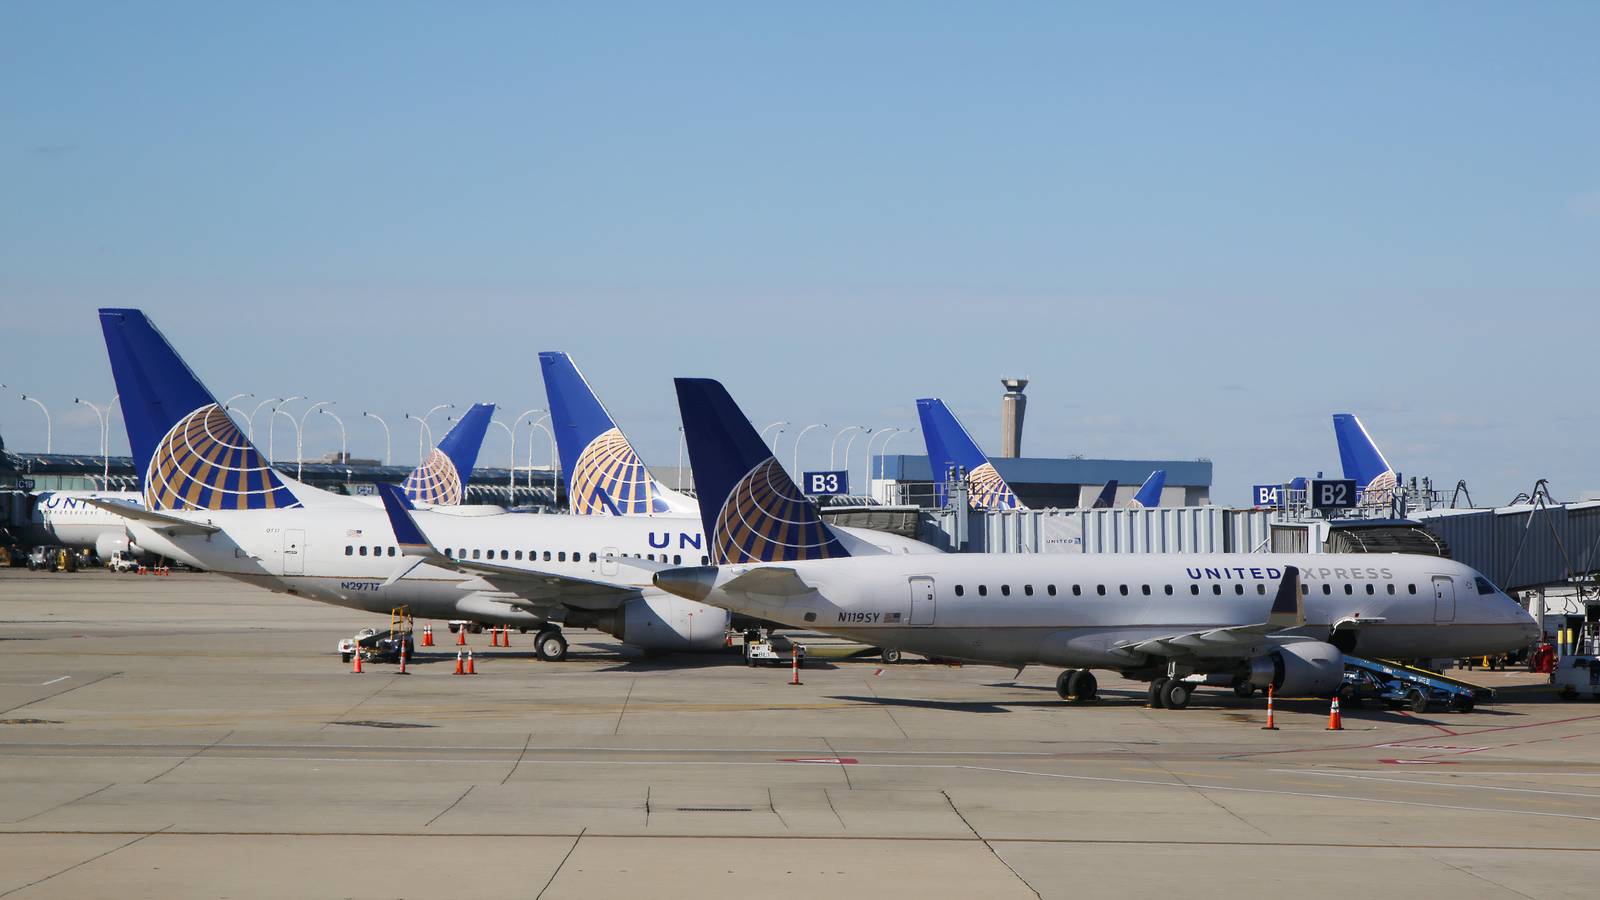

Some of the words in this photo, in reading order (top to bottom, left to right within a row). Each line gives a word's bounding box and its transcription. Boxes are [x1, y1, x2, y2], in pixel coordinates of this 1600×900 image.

[812, 474, 838, 492] B3
[1259, 487, 1277, 504] B4
[1321, 484, 1347, 505] B2
[1186, 567, 1281, 580] UNITED
[1300, 567, 1393, 580] XPRESS
[341, 582, 380, 591] N29717
[838, 612, 880, 623] N119SY
